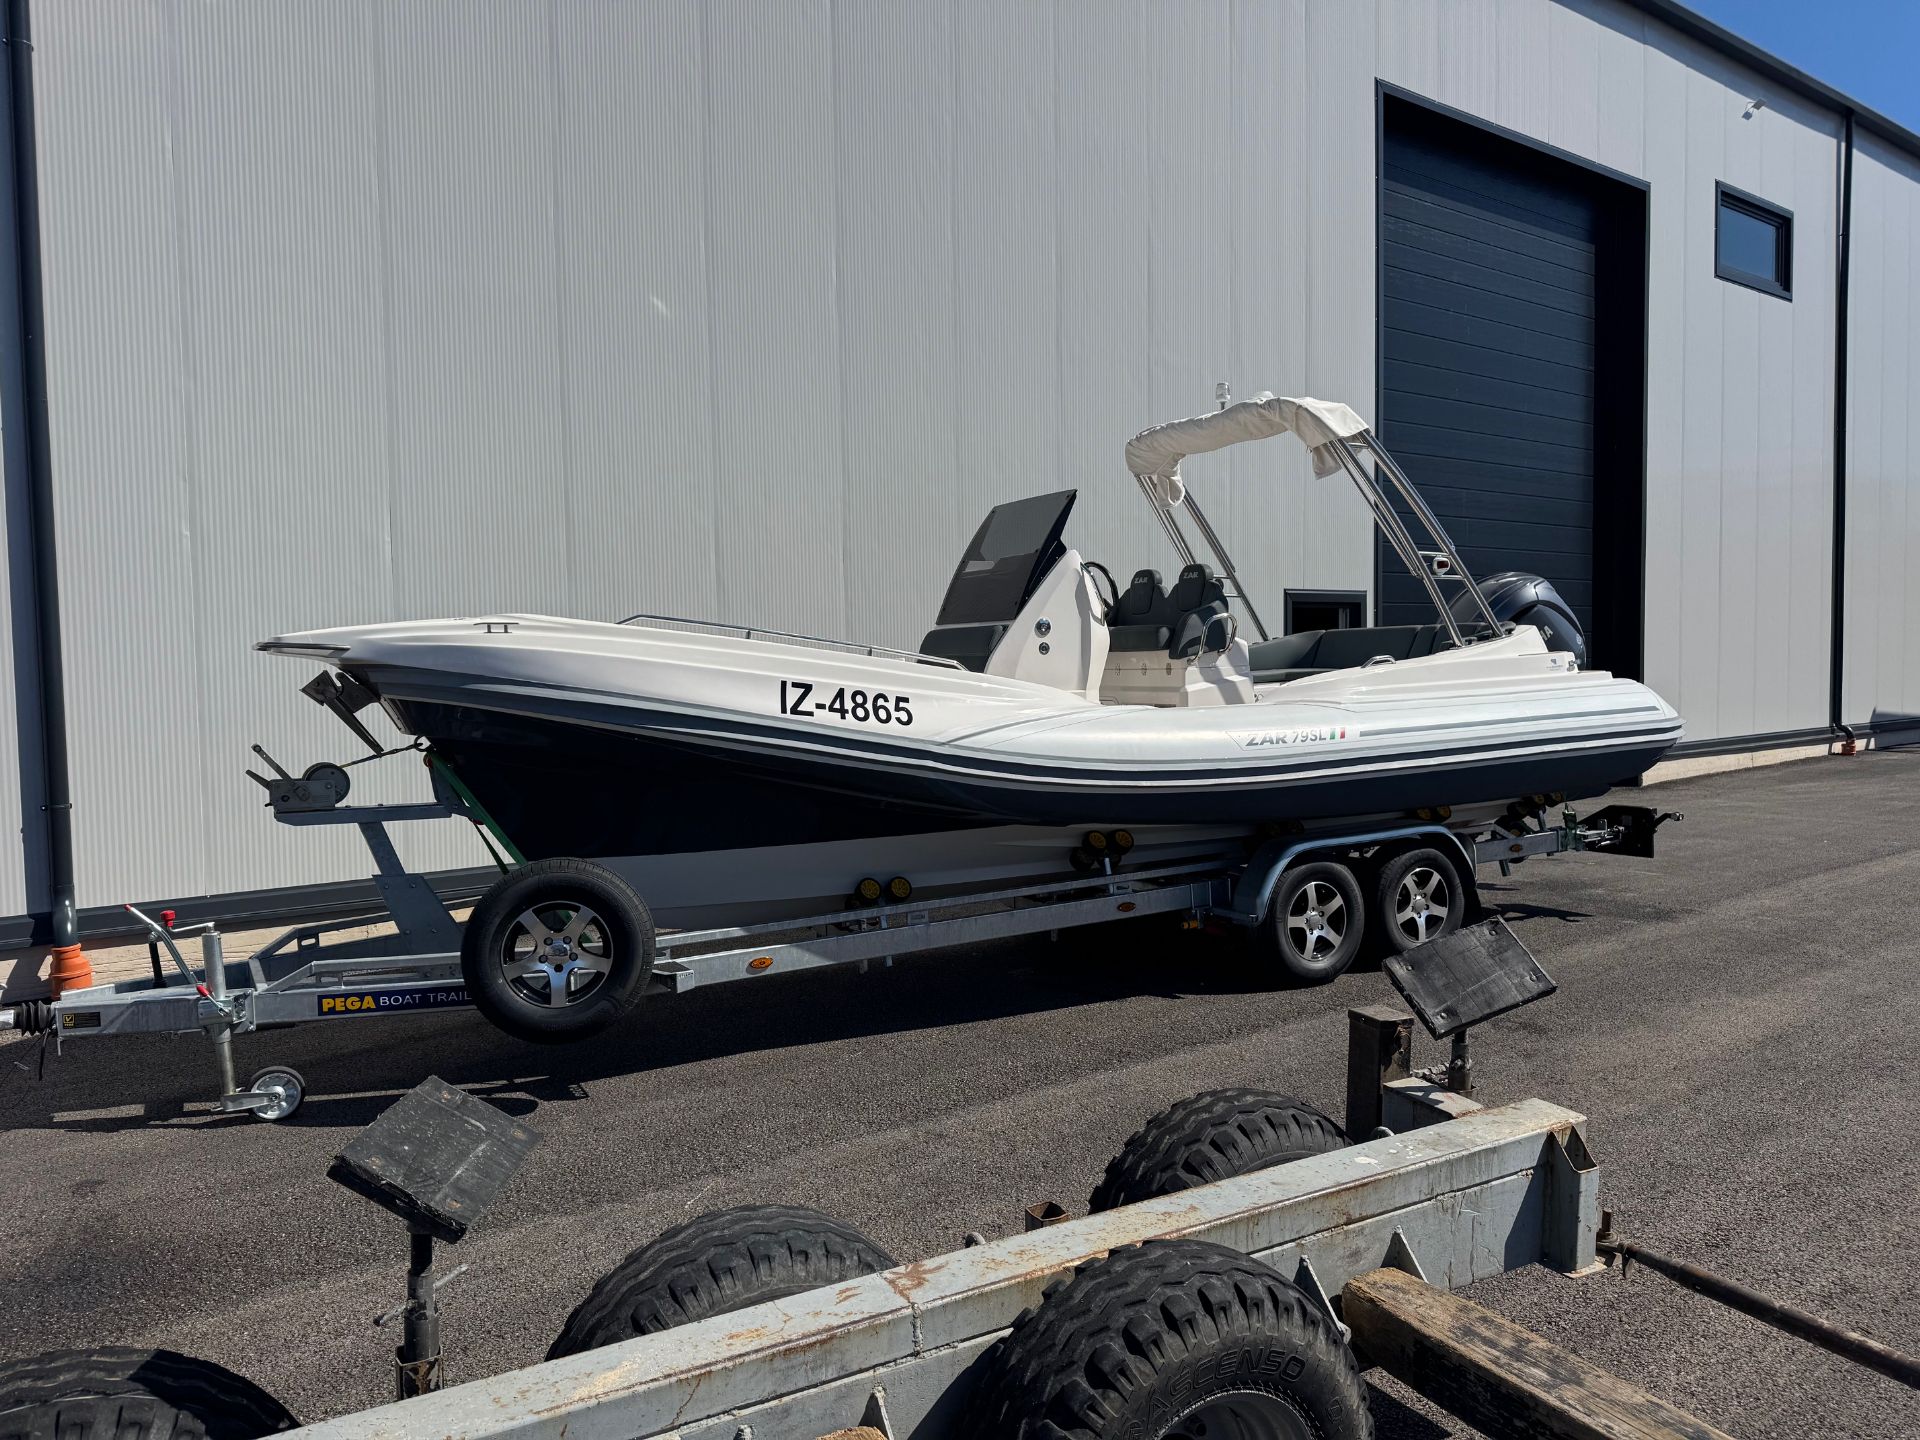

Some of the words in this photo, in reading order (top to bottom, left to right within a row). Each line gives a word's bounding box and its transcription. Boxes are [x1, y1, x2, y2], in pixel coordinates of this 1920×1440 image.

[780, 680, 914, 726] IZ-4865
[1245, 732, 1288, 747] ZAR
[1292, 729, 1327, 744] 79SL
[322, 995, 377, 1012] PEGA
[380, 994, 422, 1006] BOAT
[427, 991, 473, 1003] TRAIL
[1149, 1347, 1306, 1416] ASCENSO
